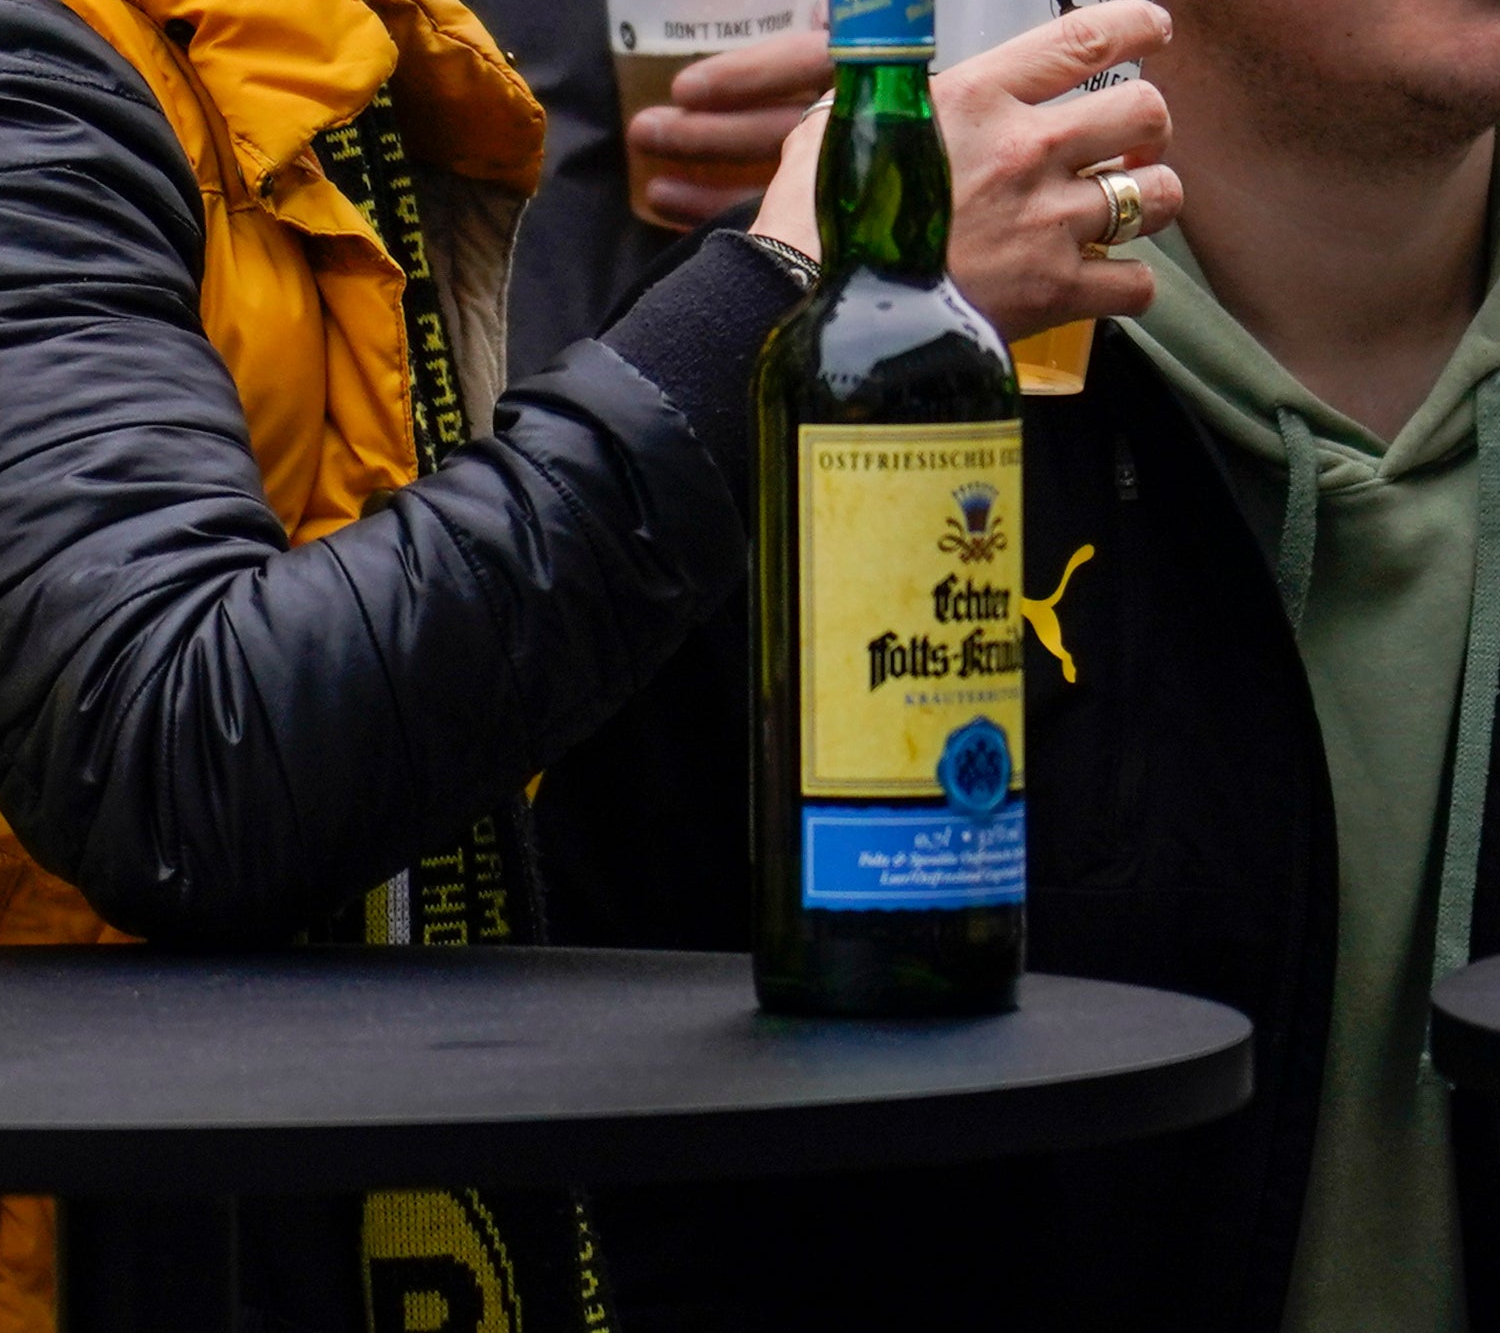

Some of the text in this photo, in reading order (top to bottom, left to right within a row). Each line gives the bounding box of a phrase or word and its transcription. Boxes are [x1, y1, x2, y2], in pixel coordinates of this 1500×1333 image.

[664, 10, 794, 40] DON'T TAKE YOUR
